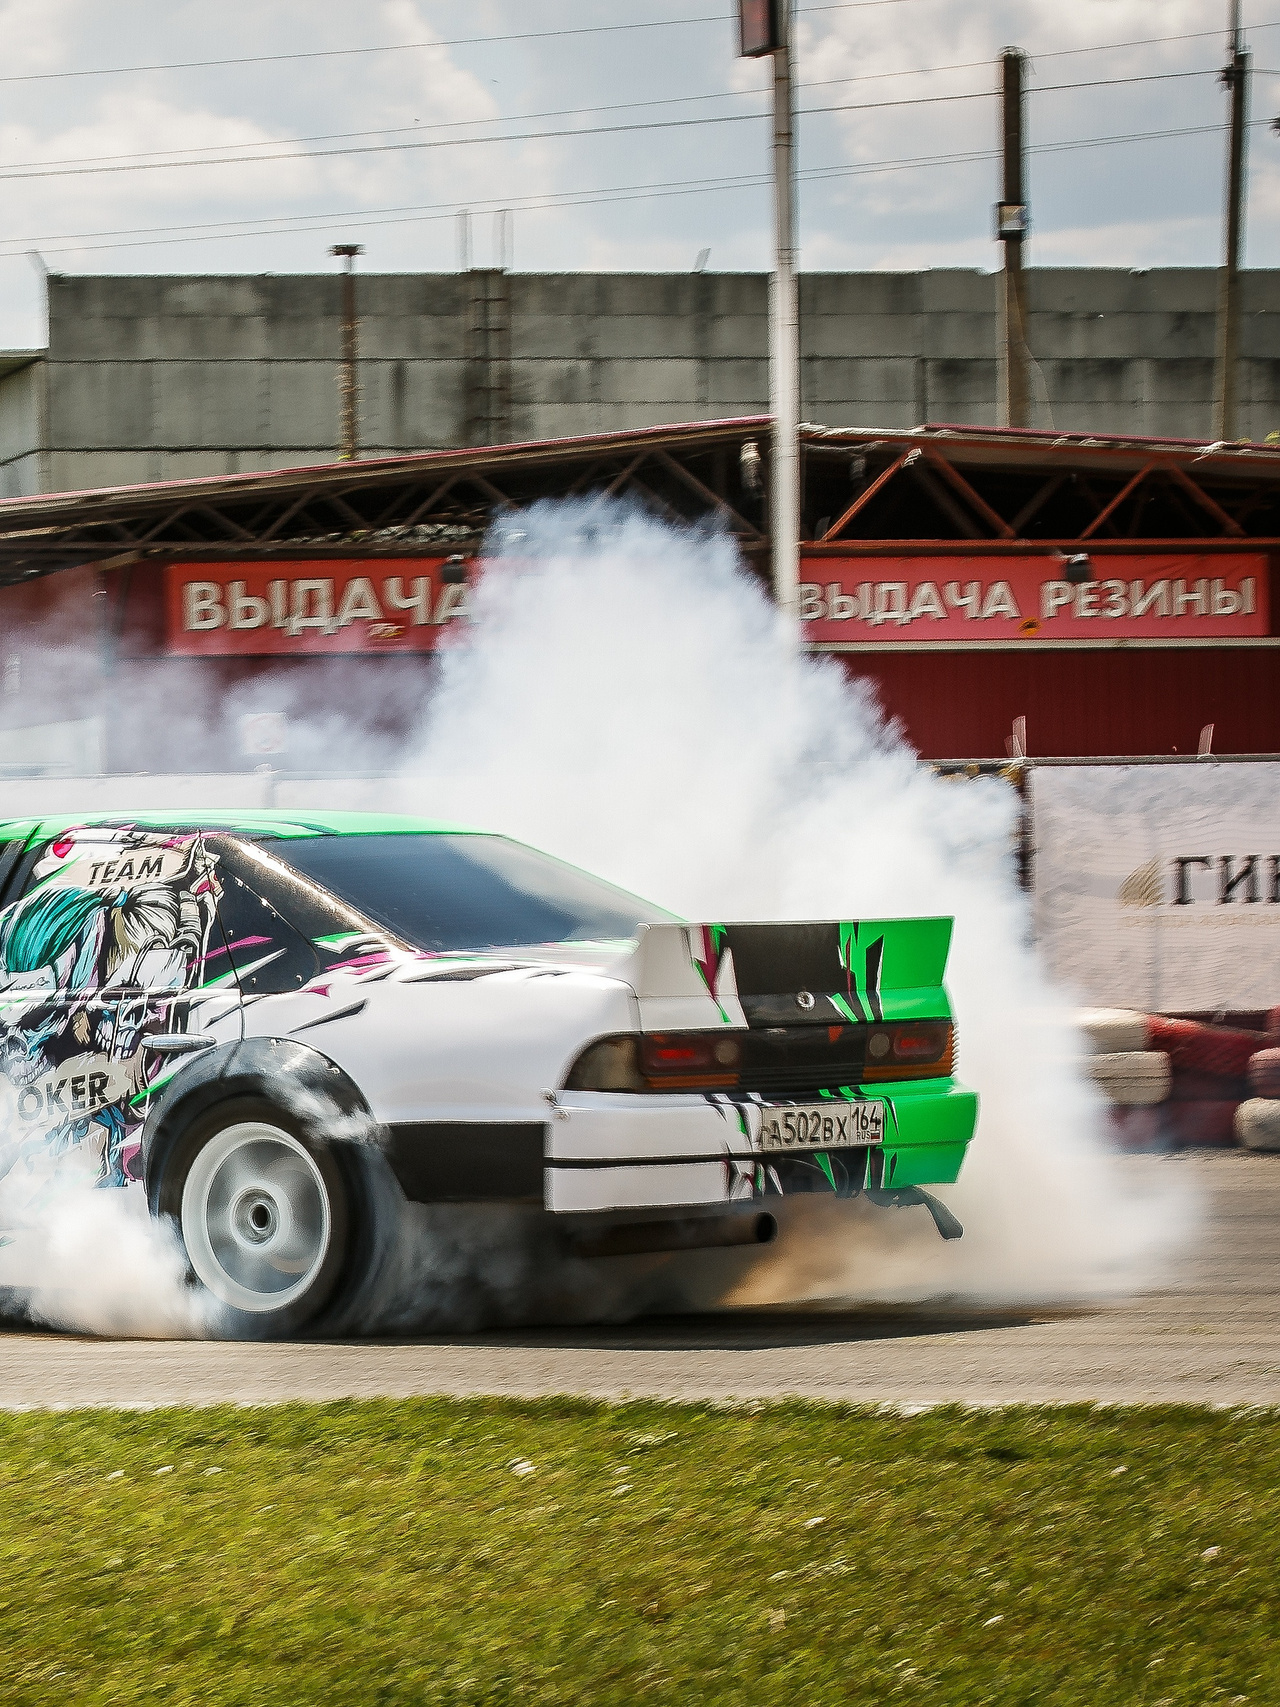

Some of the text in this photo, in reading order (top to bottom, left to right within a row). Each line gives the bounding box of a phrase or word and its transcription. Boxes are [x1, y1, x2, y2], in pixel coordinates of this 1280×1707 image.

[182, 577, 481, 636] ВЫДАЧА
[798, 577, 1257, 627] ВЫДАЧА РЕЗИНЫ
[88, 854, 165, 886] TEAM
[17, 1071, 110, 1121] OKER
[852, 1105, 881, 1131] 164
[856, 1130, 871, 1142] RUS
